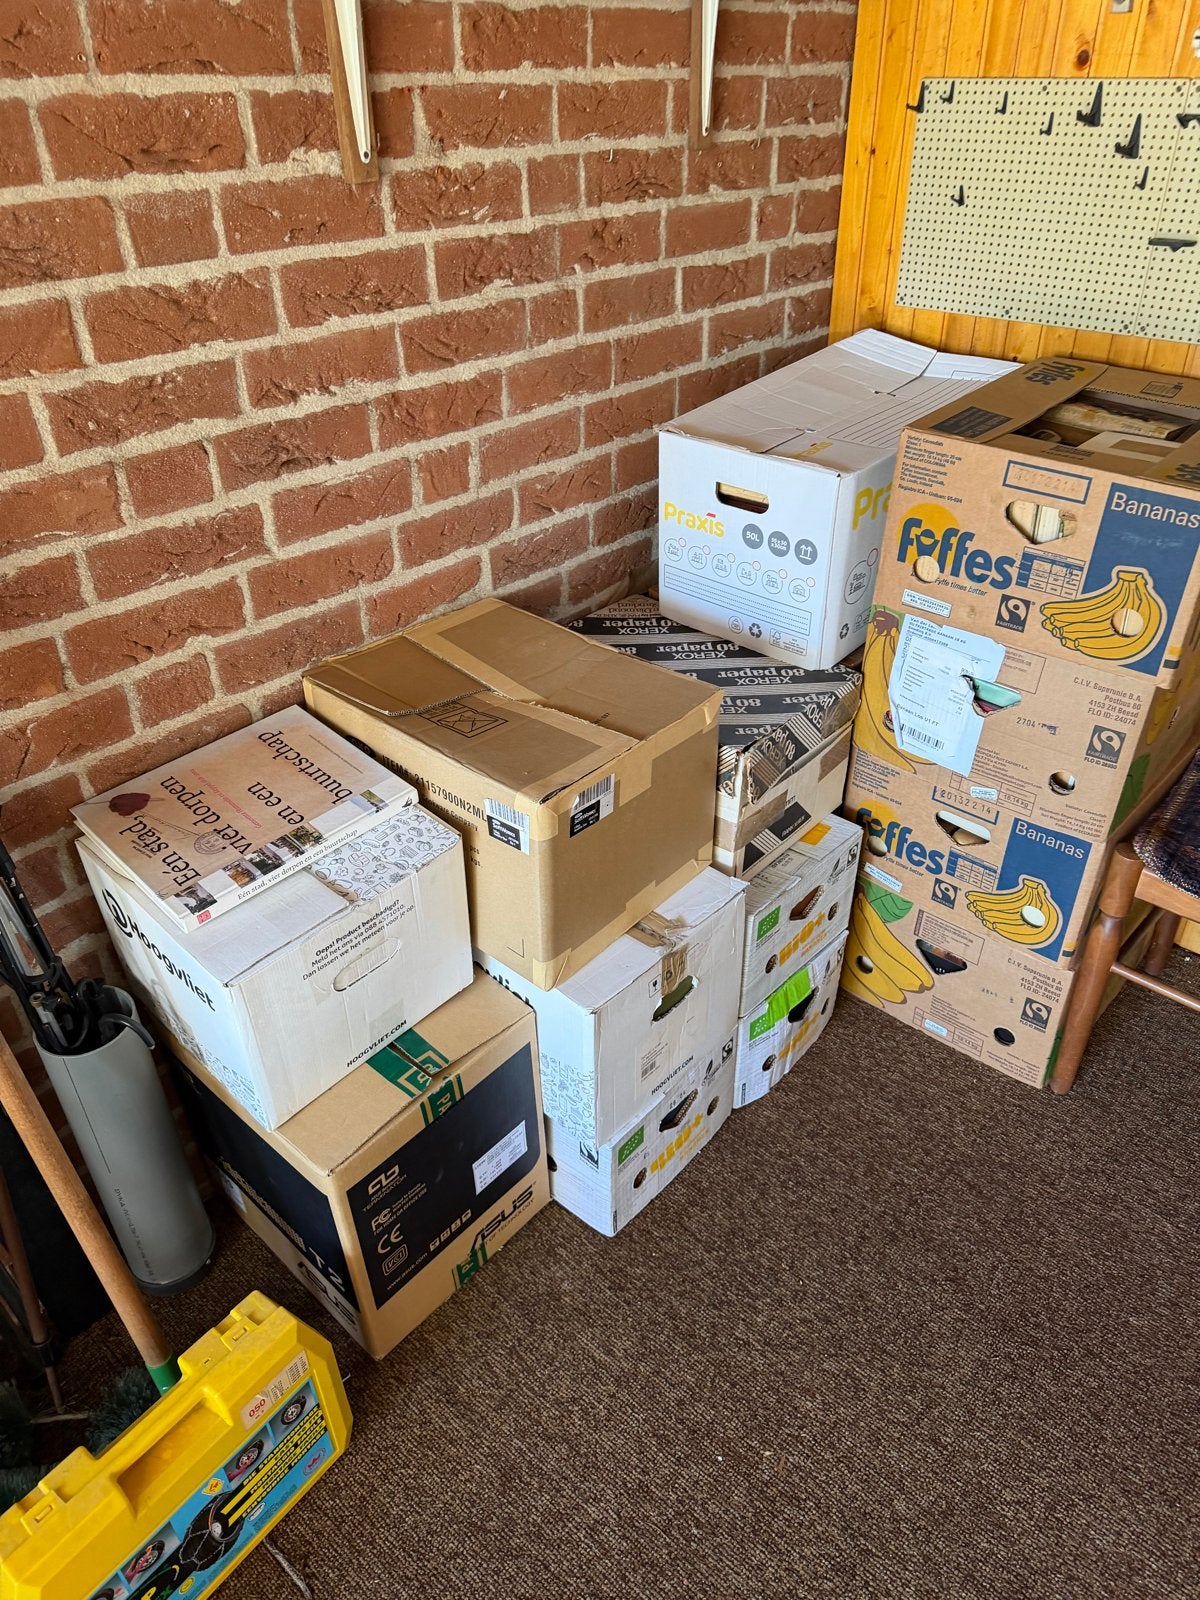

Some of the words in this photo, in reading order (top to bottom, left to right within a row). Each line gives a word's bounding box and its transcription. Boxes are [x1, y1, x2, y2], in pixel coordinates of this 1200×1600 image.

[664, 502, 725, 538] Praxis
[1110, 492, 1200, 528] Bananas
[745, 530, 760, 542] 50L
[602, 618, 657, 627] paper
[618, 626, 670, 634] XEROX
[656, 642, 710, 652] paper
[672, 651, 726, 660] XEROX
[713, 642, 740, 650] 80
[718, 668, 778, 678] paper
[736, 676, 792, 685] XEROX
[780, 668, 806, 676] 80
[736, 699, 762, 707] 80
[1128, 692, 1143, 702] B.A.
[258, 730, 352, 804] buurtschap
[160, 776, 221, 826] dorpen
[248, 781, 282, 807] een
[278, 805, 305, 825] en
[118, 814, 169, 854] stad,
[212, 824, 253, 854] vier
[1015, 821, 1085, 860] Bananas
[162, 850, 201, 886] Eén
[238, 888, 250, 899] Eén
[250, 879, 267, 892] stad,
[266, 871, 281, 882] vier
[279, 858, 304, 877] dorpen
[303, 854, 312, 862] en
[311, 848, 323, 857] een
[323, 827, 359, 852] buurtschap
[310, 953, 329, 967] Meld
[328, 945, 340, 956] het
[340, 938, 353, 948] ons
[353, 930, 364, 939] via
[363, 921, 378, 933] 088
[314, 941, 336, 957] Oeps!
[334, 925, 361, 943] Product
[360, 899, 402, 927] beschadigd?
[130, 914, 216, 1012] Hoogvliet
[301, 968, 317, 980] Dan
[315, 954, 339, 971] lossen
[338, 948, 349, 956] we
[349, 940, 361, 950] het
[360, 925, 386, 942] meteen
[384, 915, 399, 926] voor
[346, 1020, 407, 1068] HOOGVLIET.COM
[652, 1055, 694, 1095] HOOGVLIET.COM
[470, 1184, 533, 1254] ASUS
